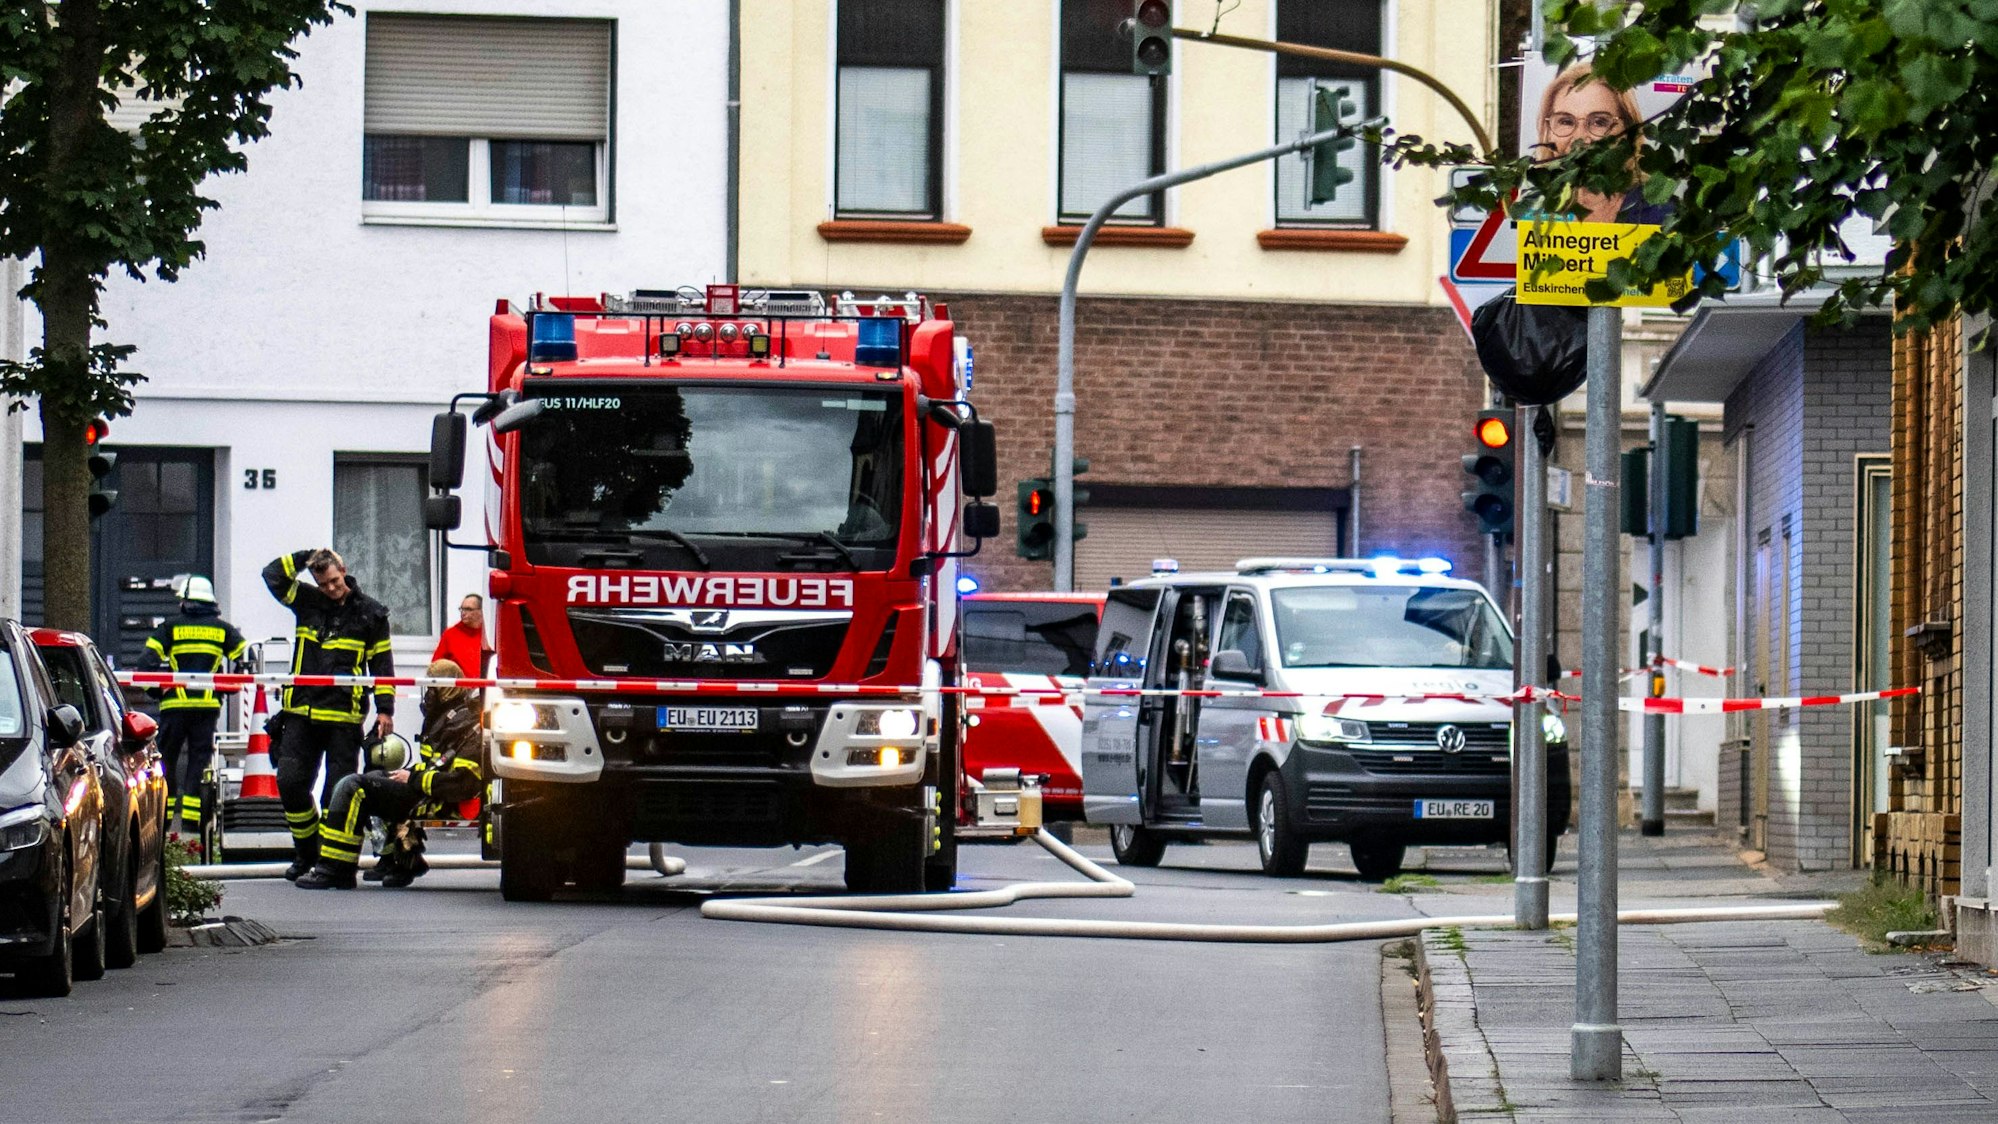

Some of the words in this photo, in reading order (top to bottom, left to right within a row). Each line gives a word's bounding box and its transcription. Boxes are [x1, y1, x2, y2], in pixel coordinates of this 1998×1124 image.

[1523, 230, 1619, 254] Annegret
[1523, 253, 1594, 272] Miert
[1523, 282, 1585, 294] Euskirchen
[565, 397, 621, 409] 11/HLF20
[664, 643, 754, 663] MAN
[668, 709, 687, 725] EU
[698, 710, 716, 726] EU
[720, 710, 756, 726] 2113
[1428, 802, 1445, 816] EU
[1454, 802, 1470, 816] RE
[1474, 803, 1489, 816] 20
